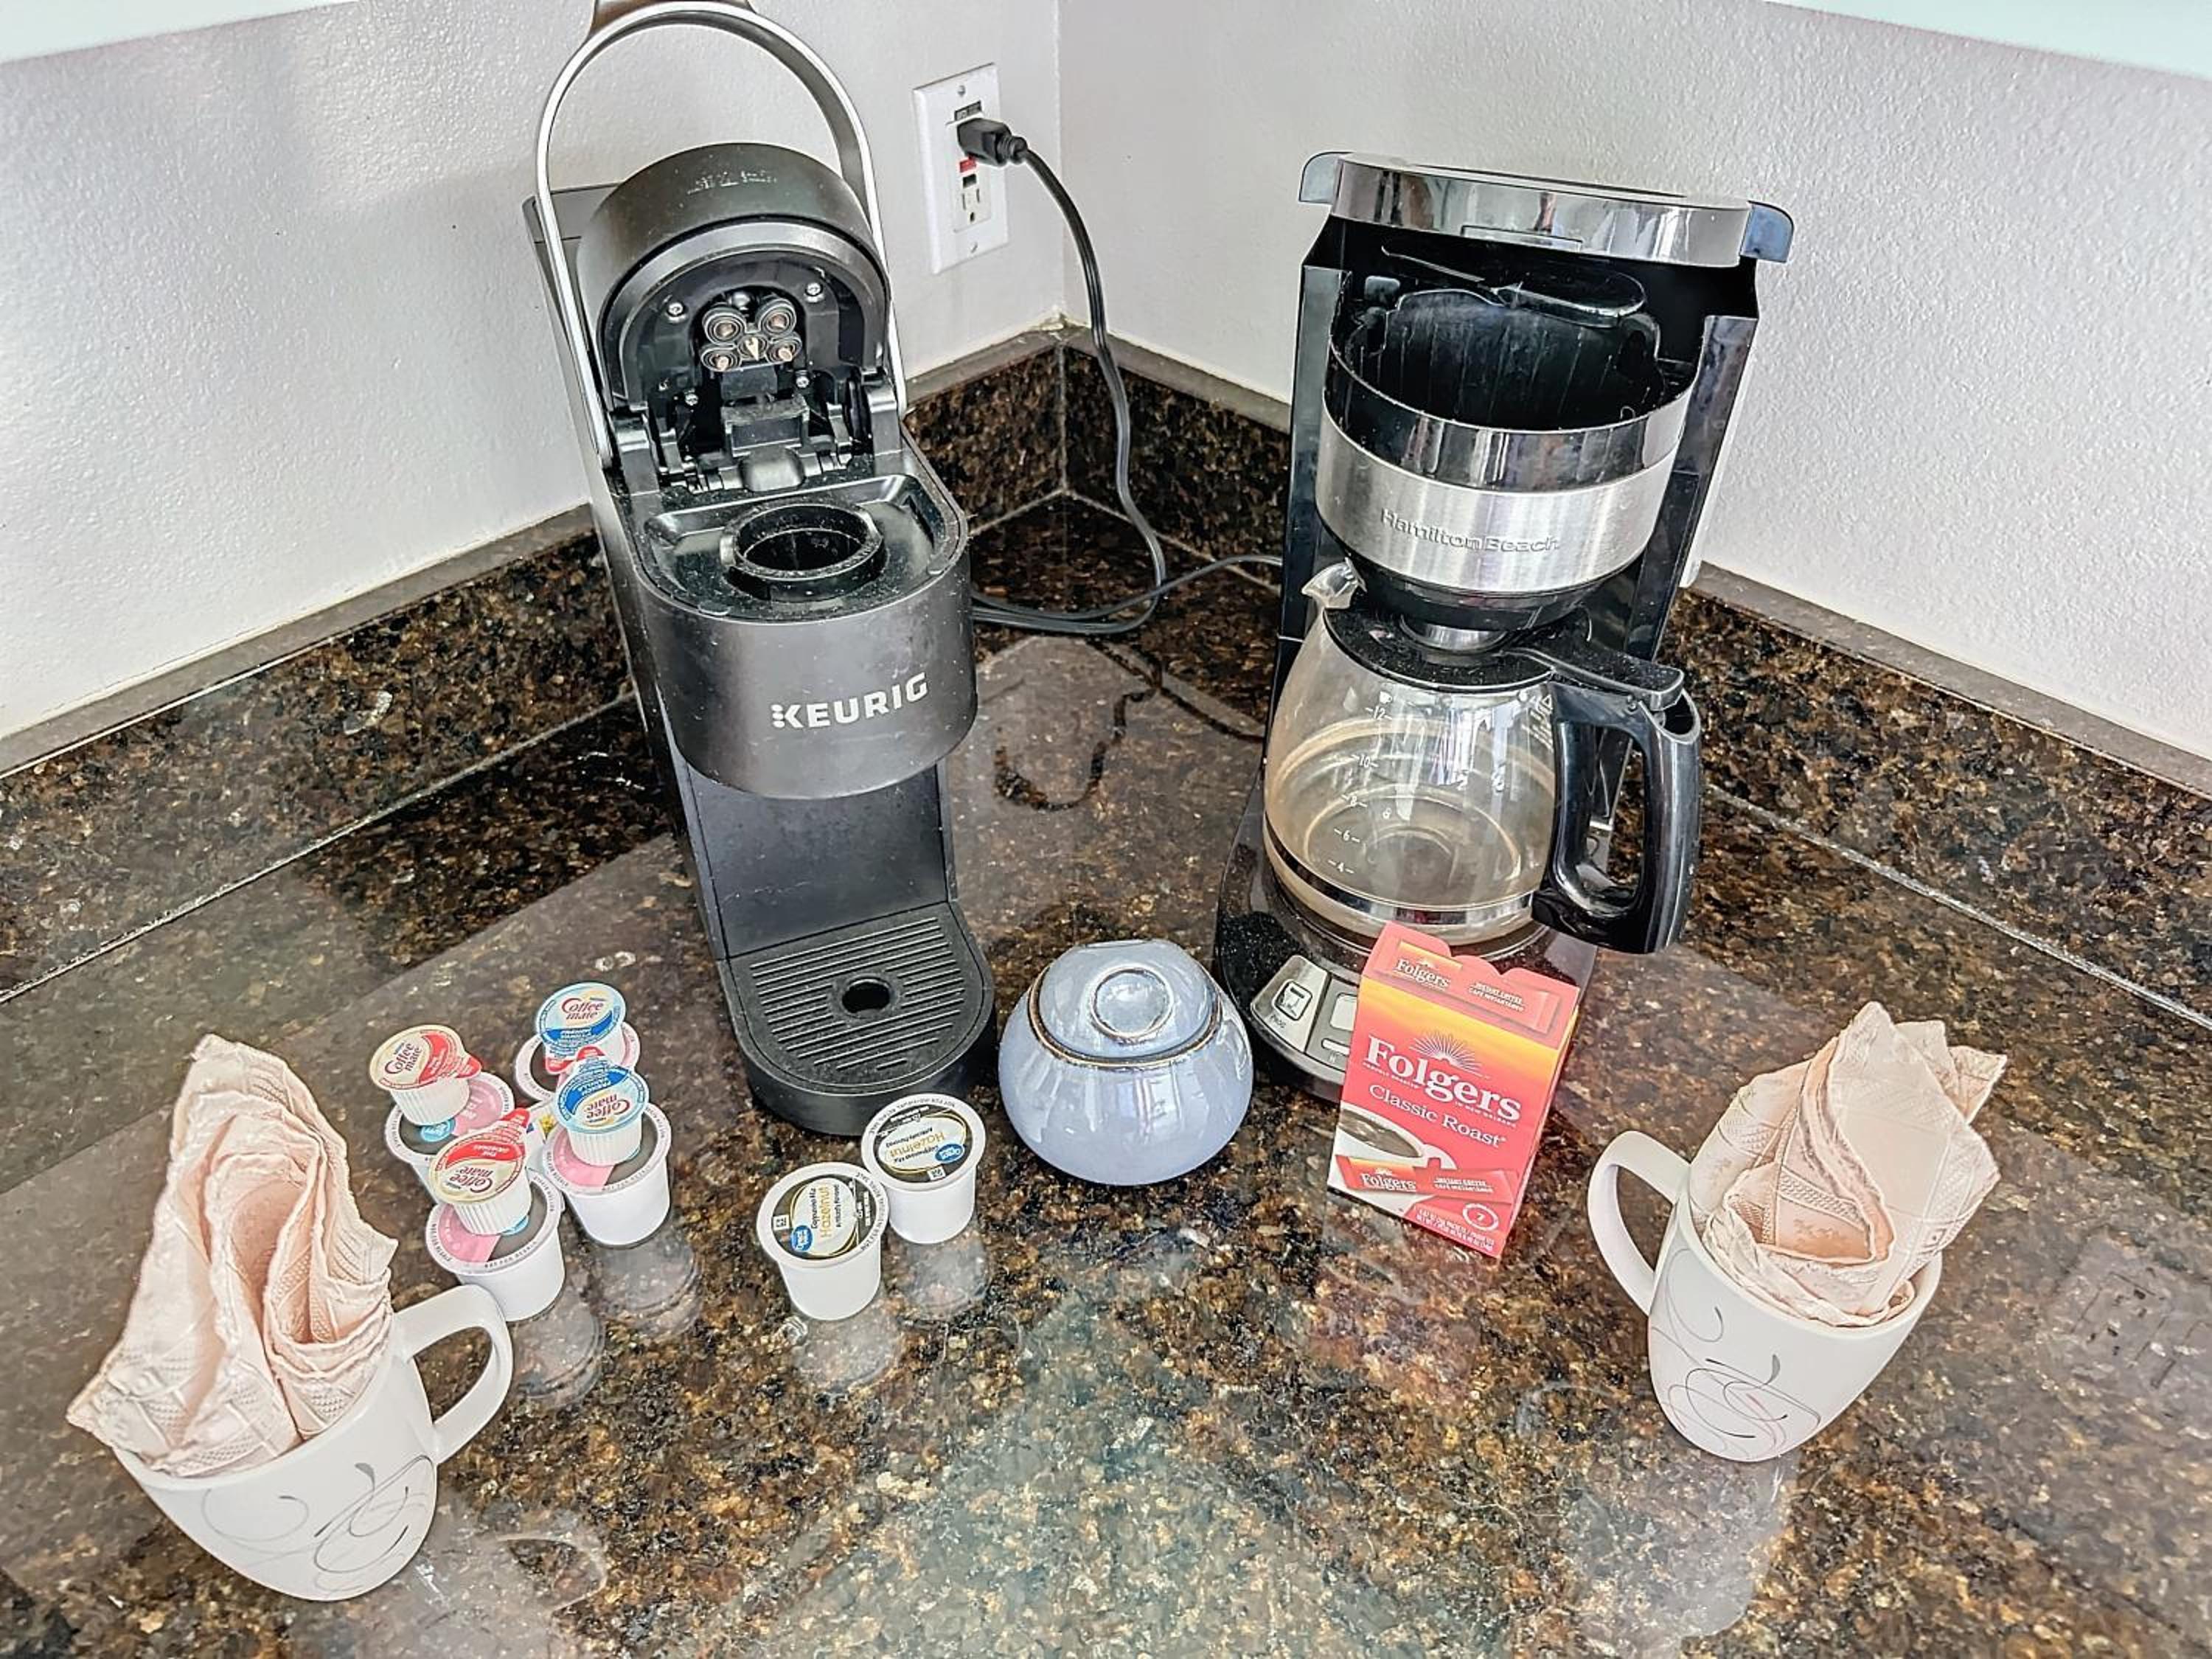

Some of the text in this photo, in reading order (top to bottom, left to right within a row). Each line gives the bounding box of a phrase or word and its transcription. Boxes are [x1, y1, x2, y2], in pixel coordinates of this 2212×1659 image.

[1381, 507, 1560, 552] Hamilton Beach
[771, 672, 928, 728] KEURIG
[1343, 830, 1350, 841] 6
[1338, 863, 1344, 872] 4
[1397, 959, 1450, 989] Folgers
[562, 998, 604, 1014] Coffee
[566, 1012, 597, 1020] mate
[384, 1043, 415, 1074] Coffee
[405, 1047, 422, 1071] mate
[1366, 1034, 1522, 1121] Folgers
[585, 1099, 630, 1119] Coffee
[587, 1093, 618, 1111] mate
[1369, 1085, 1438, 1122] Classic
[890, 1132, 945, 1157] Hazelnut
[459, 1166, 493, 1178] mate
[1361, 1172, 1416, 1192] Folgers
[449, 1174, 493, 1194] Coffee
[818, 1186, 832, 1238] Hazelnut
